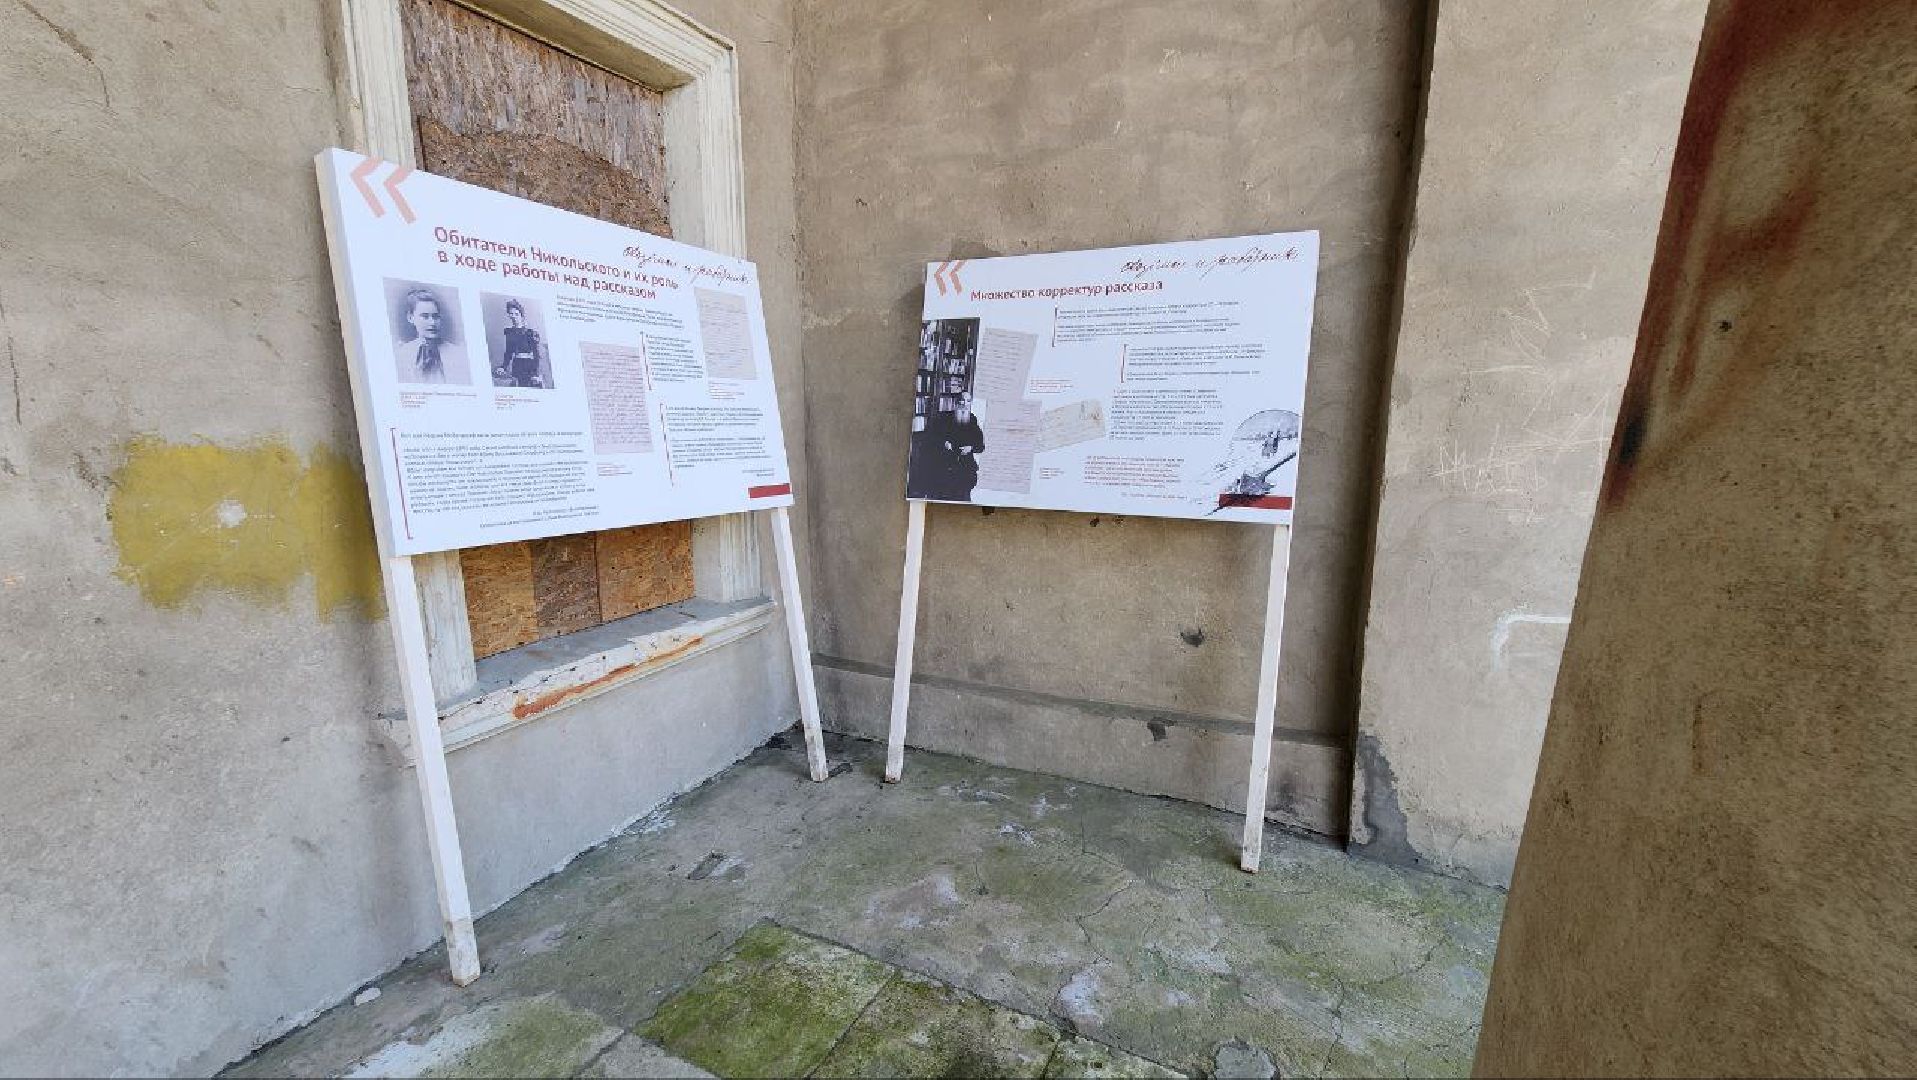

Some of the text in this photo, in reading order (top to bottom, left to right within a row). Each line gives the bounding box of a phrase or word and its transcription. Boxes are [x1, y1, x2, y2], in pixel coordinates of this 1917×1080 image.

[434, 226, 679, 290] Обитатели Никольского и их роль
[437, 250, 656, 300] в ходе работы над рассказом
[970, 280, 1163, 301] Множество корректур рассказа
